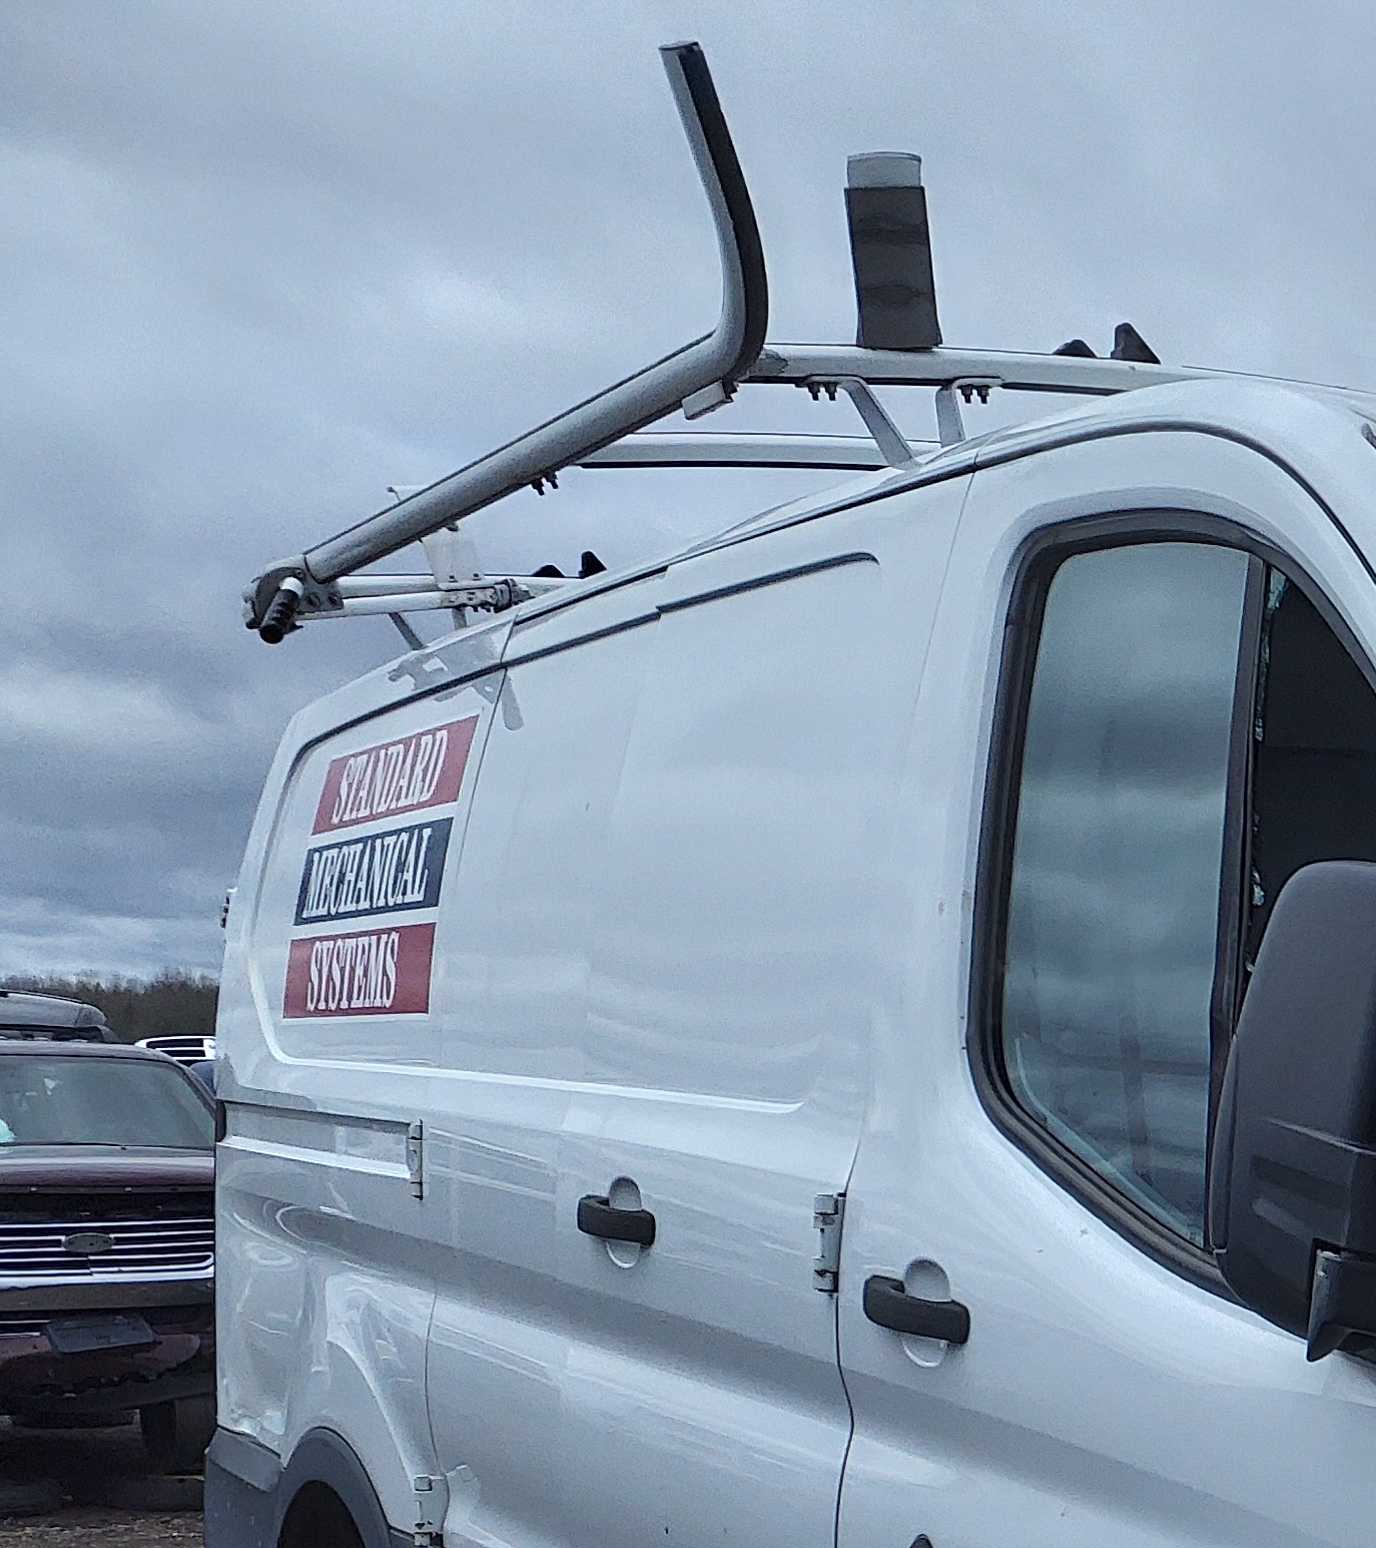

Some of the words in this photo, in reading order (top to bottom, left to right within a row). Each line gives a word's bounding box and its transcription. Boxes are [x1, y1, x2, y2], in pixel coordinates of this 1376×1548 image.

[331, 729, 449, 824] STANDARD
[302, 826, 433, 920] MECHANICAL
[307, 931, 398, 1012] SYSTEMS
